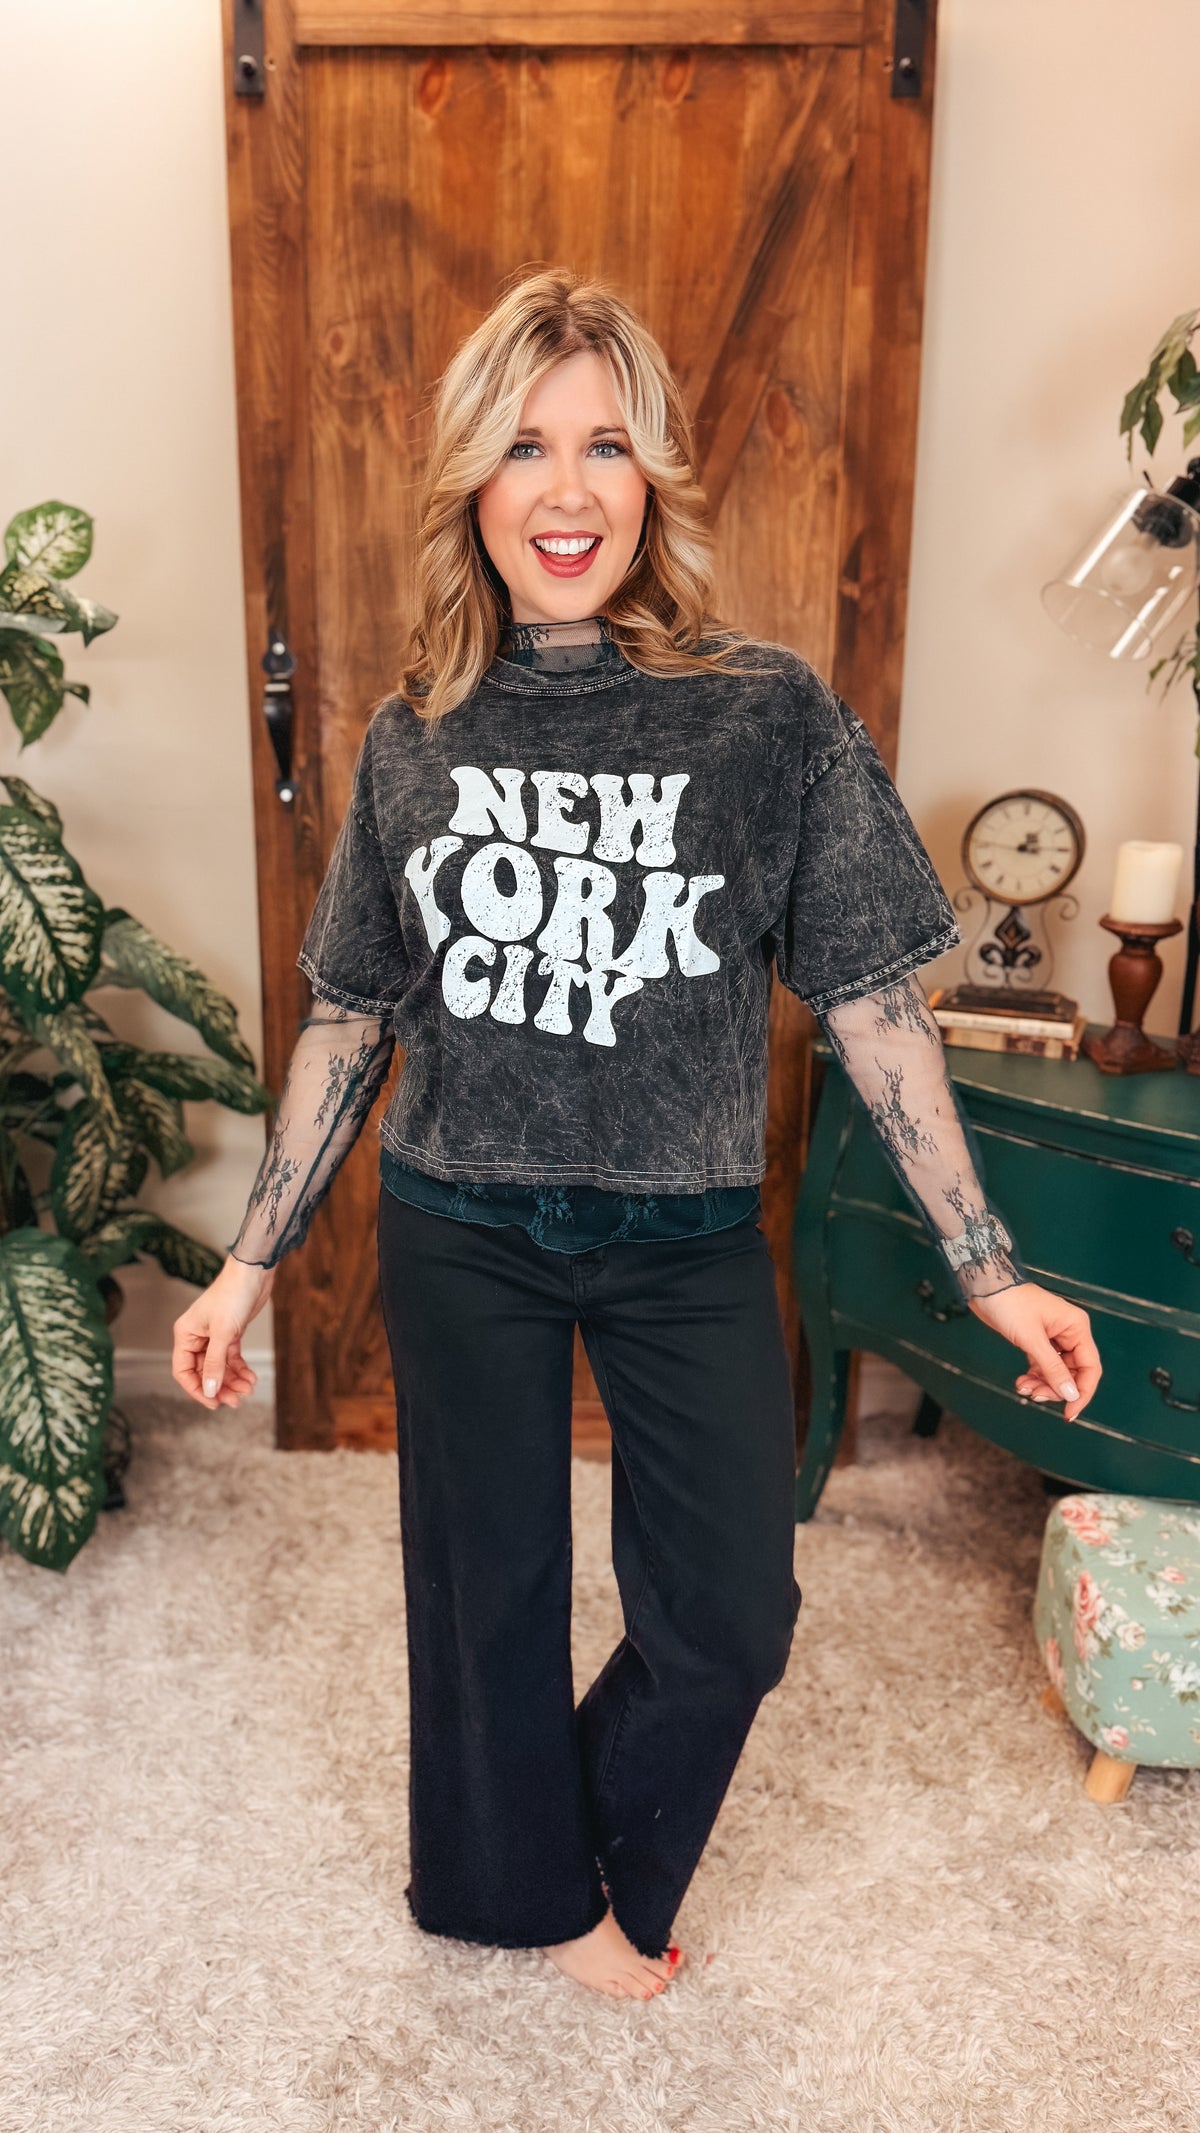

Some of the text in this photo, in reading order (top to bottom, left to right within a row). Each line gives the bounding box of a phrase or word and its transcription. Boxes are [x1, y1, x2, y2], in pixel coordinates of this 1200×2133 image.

[449, 766, 690, 867] NEW
[404, 836, 725, 978] YORK
[442, 936, 644, 1047] CITY
